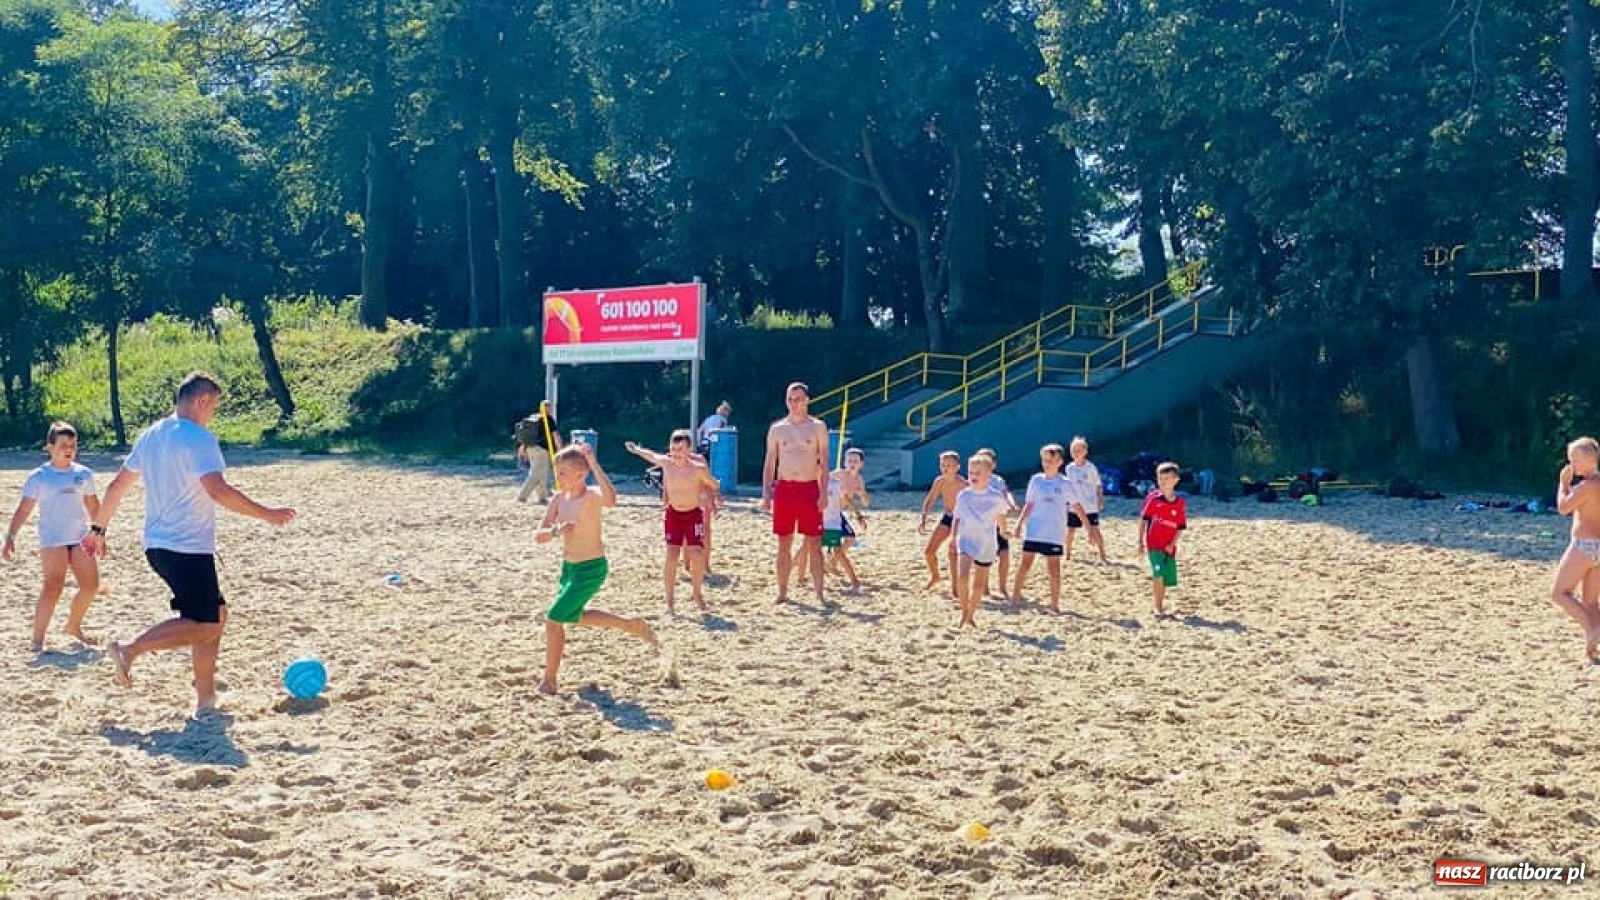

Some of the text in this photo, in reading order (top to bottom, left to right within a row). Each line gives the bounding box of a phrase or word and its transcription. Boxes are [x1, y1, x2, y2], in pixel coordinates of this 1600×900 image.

[602, 298, 677, 319] 601 100 100
